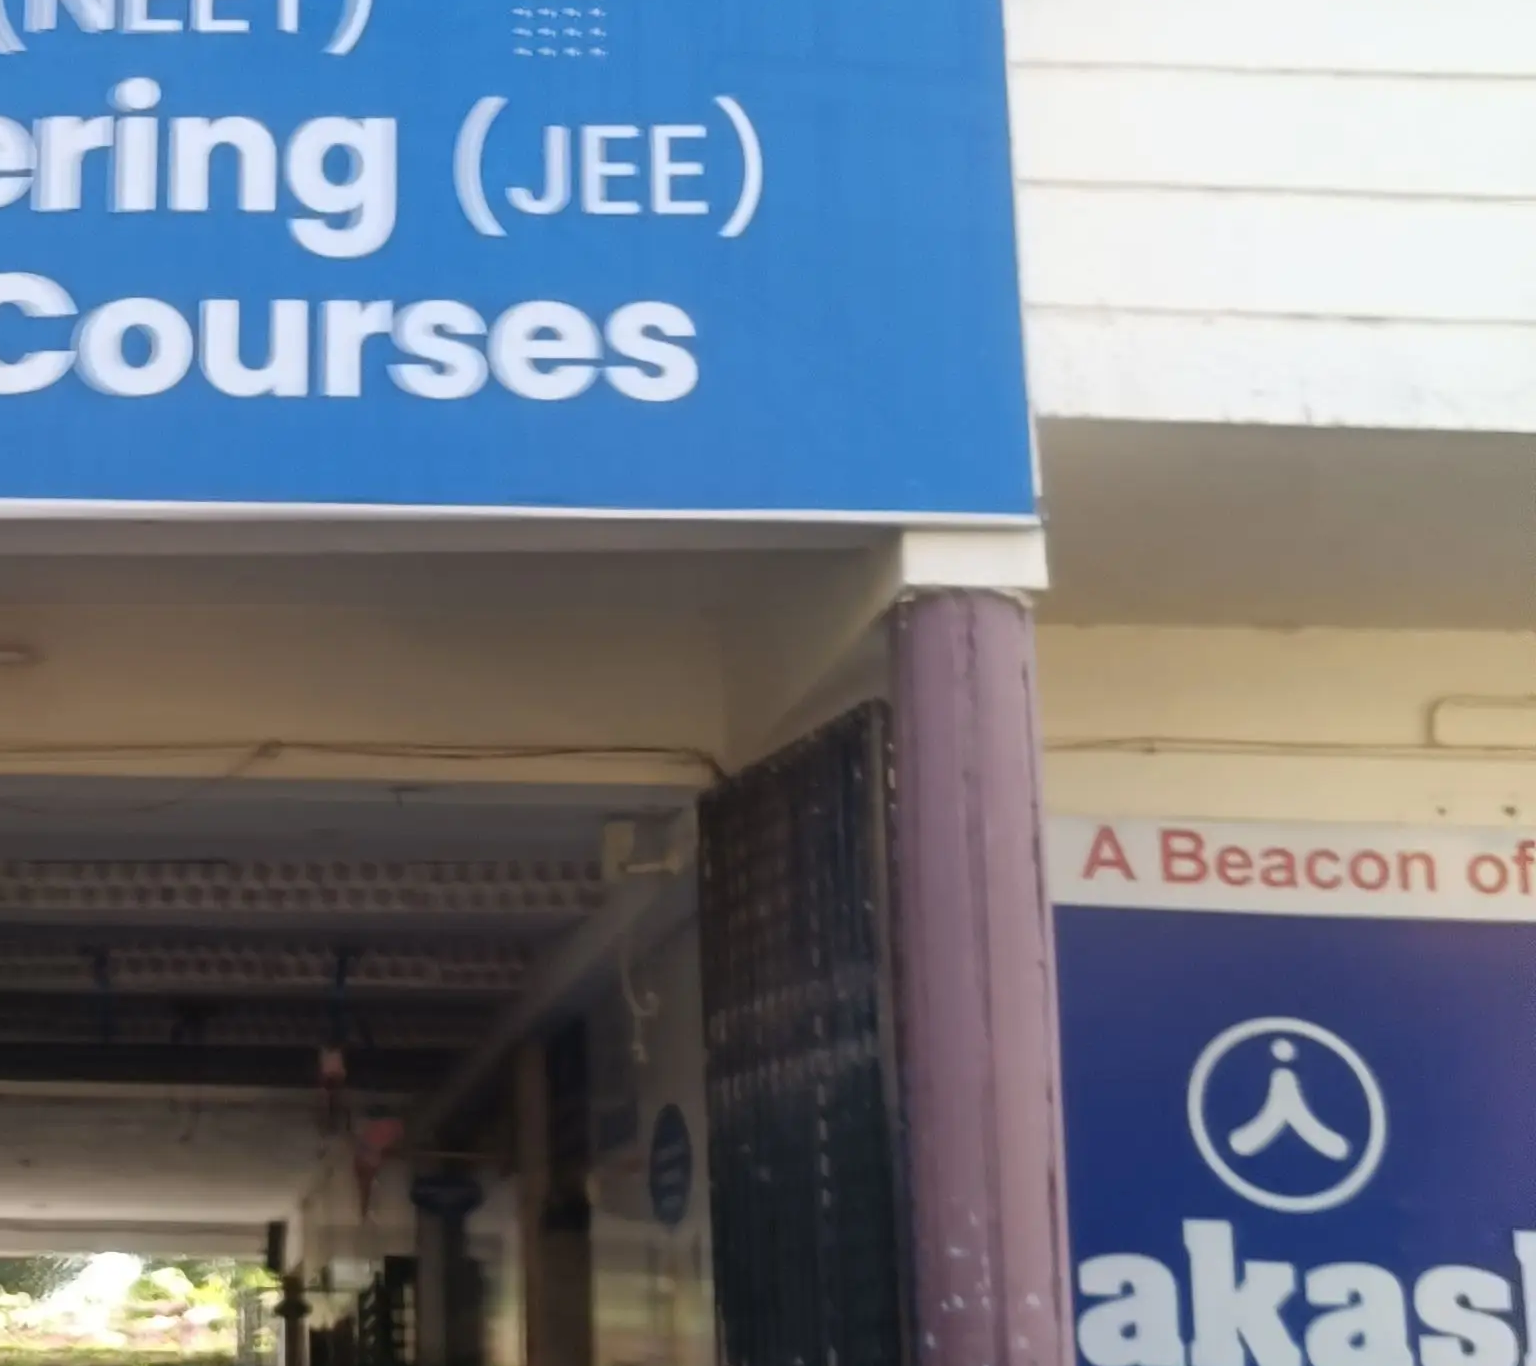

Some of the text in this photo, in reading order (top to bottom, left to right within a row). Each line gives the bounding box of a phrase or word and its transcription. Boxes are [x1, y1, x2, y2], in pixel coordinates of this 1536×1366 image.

[453, 95, 763, 238] (JEE)
[1082, 825, 1136, 882] A
[1158, 828, 1438, 893] Beacon
